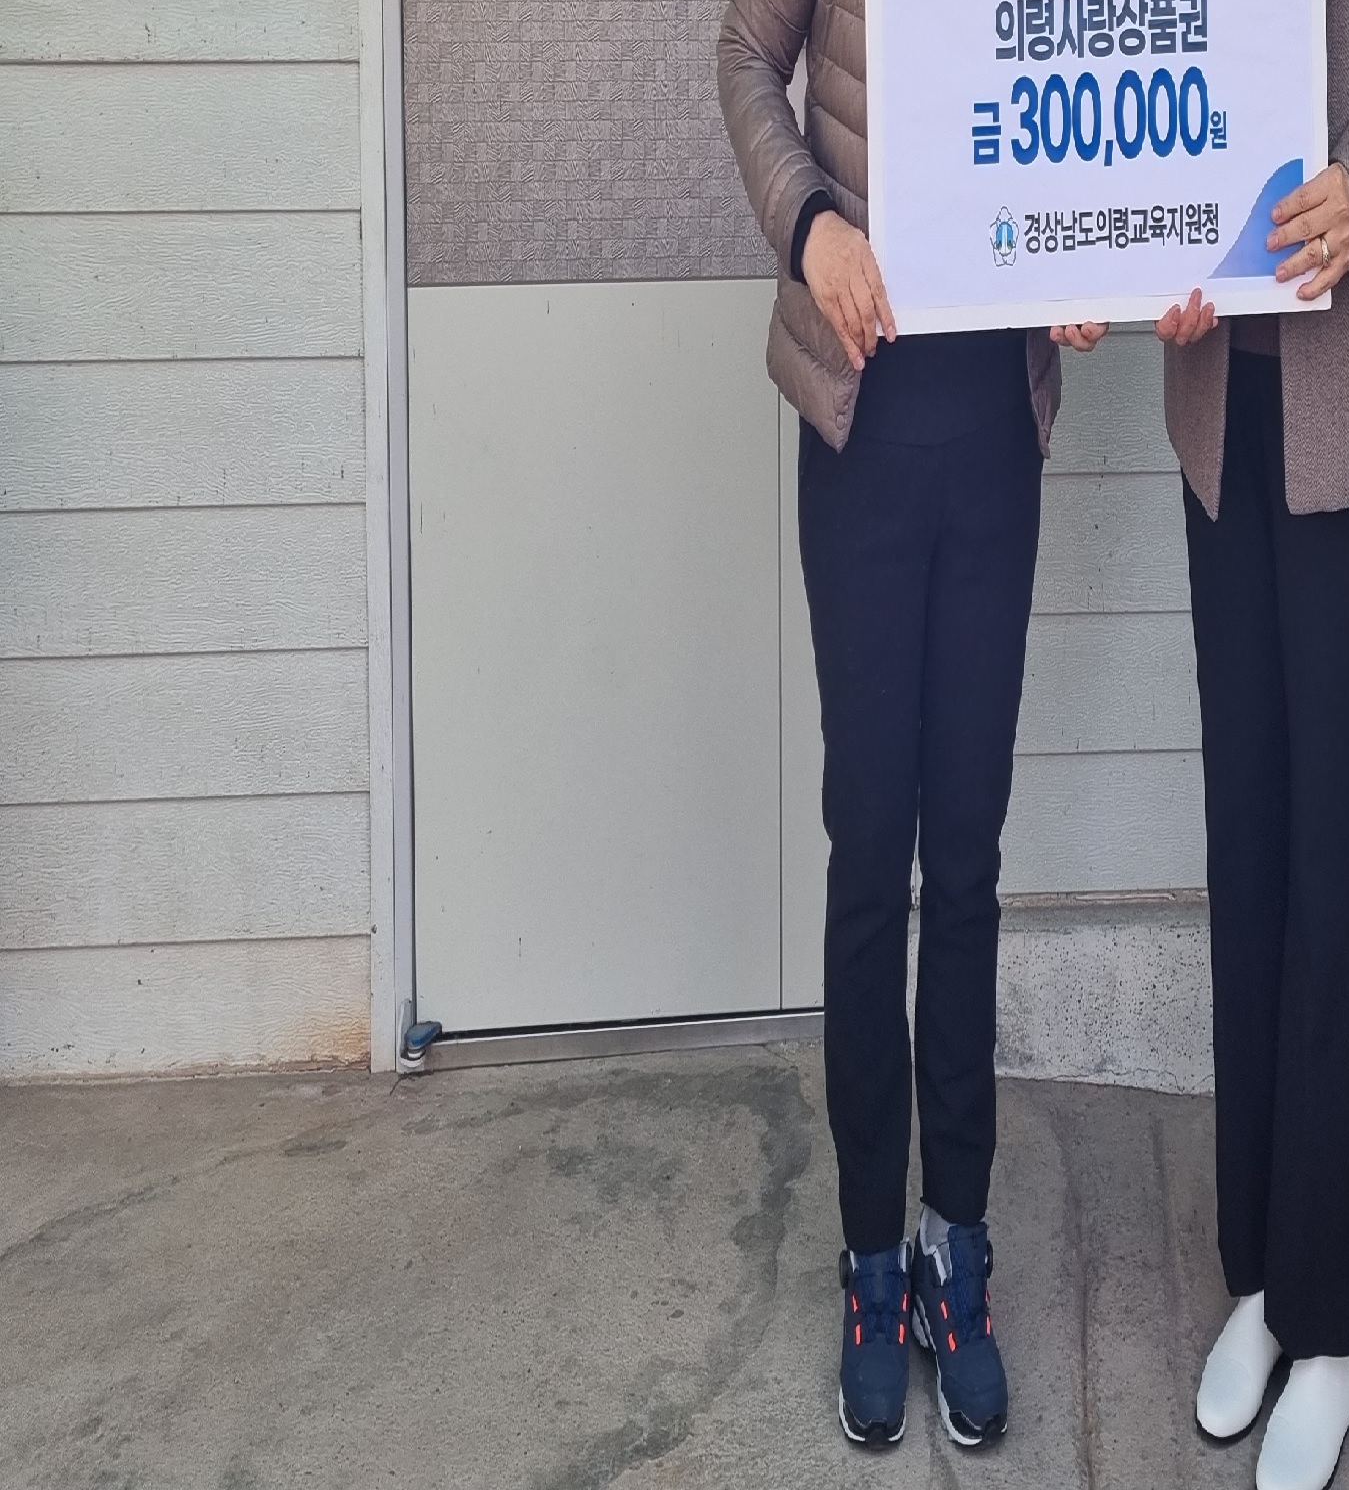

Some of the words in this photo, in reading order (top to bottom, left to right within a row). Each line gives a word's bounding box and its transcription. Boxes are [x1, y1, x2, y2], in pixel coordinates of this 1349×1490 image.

[971, 101, 1002, 165] 금
[1010, 66, 1228, 168] 300,000원
[1023, 204, 1220, 255] 경상남도의령교육지원청
